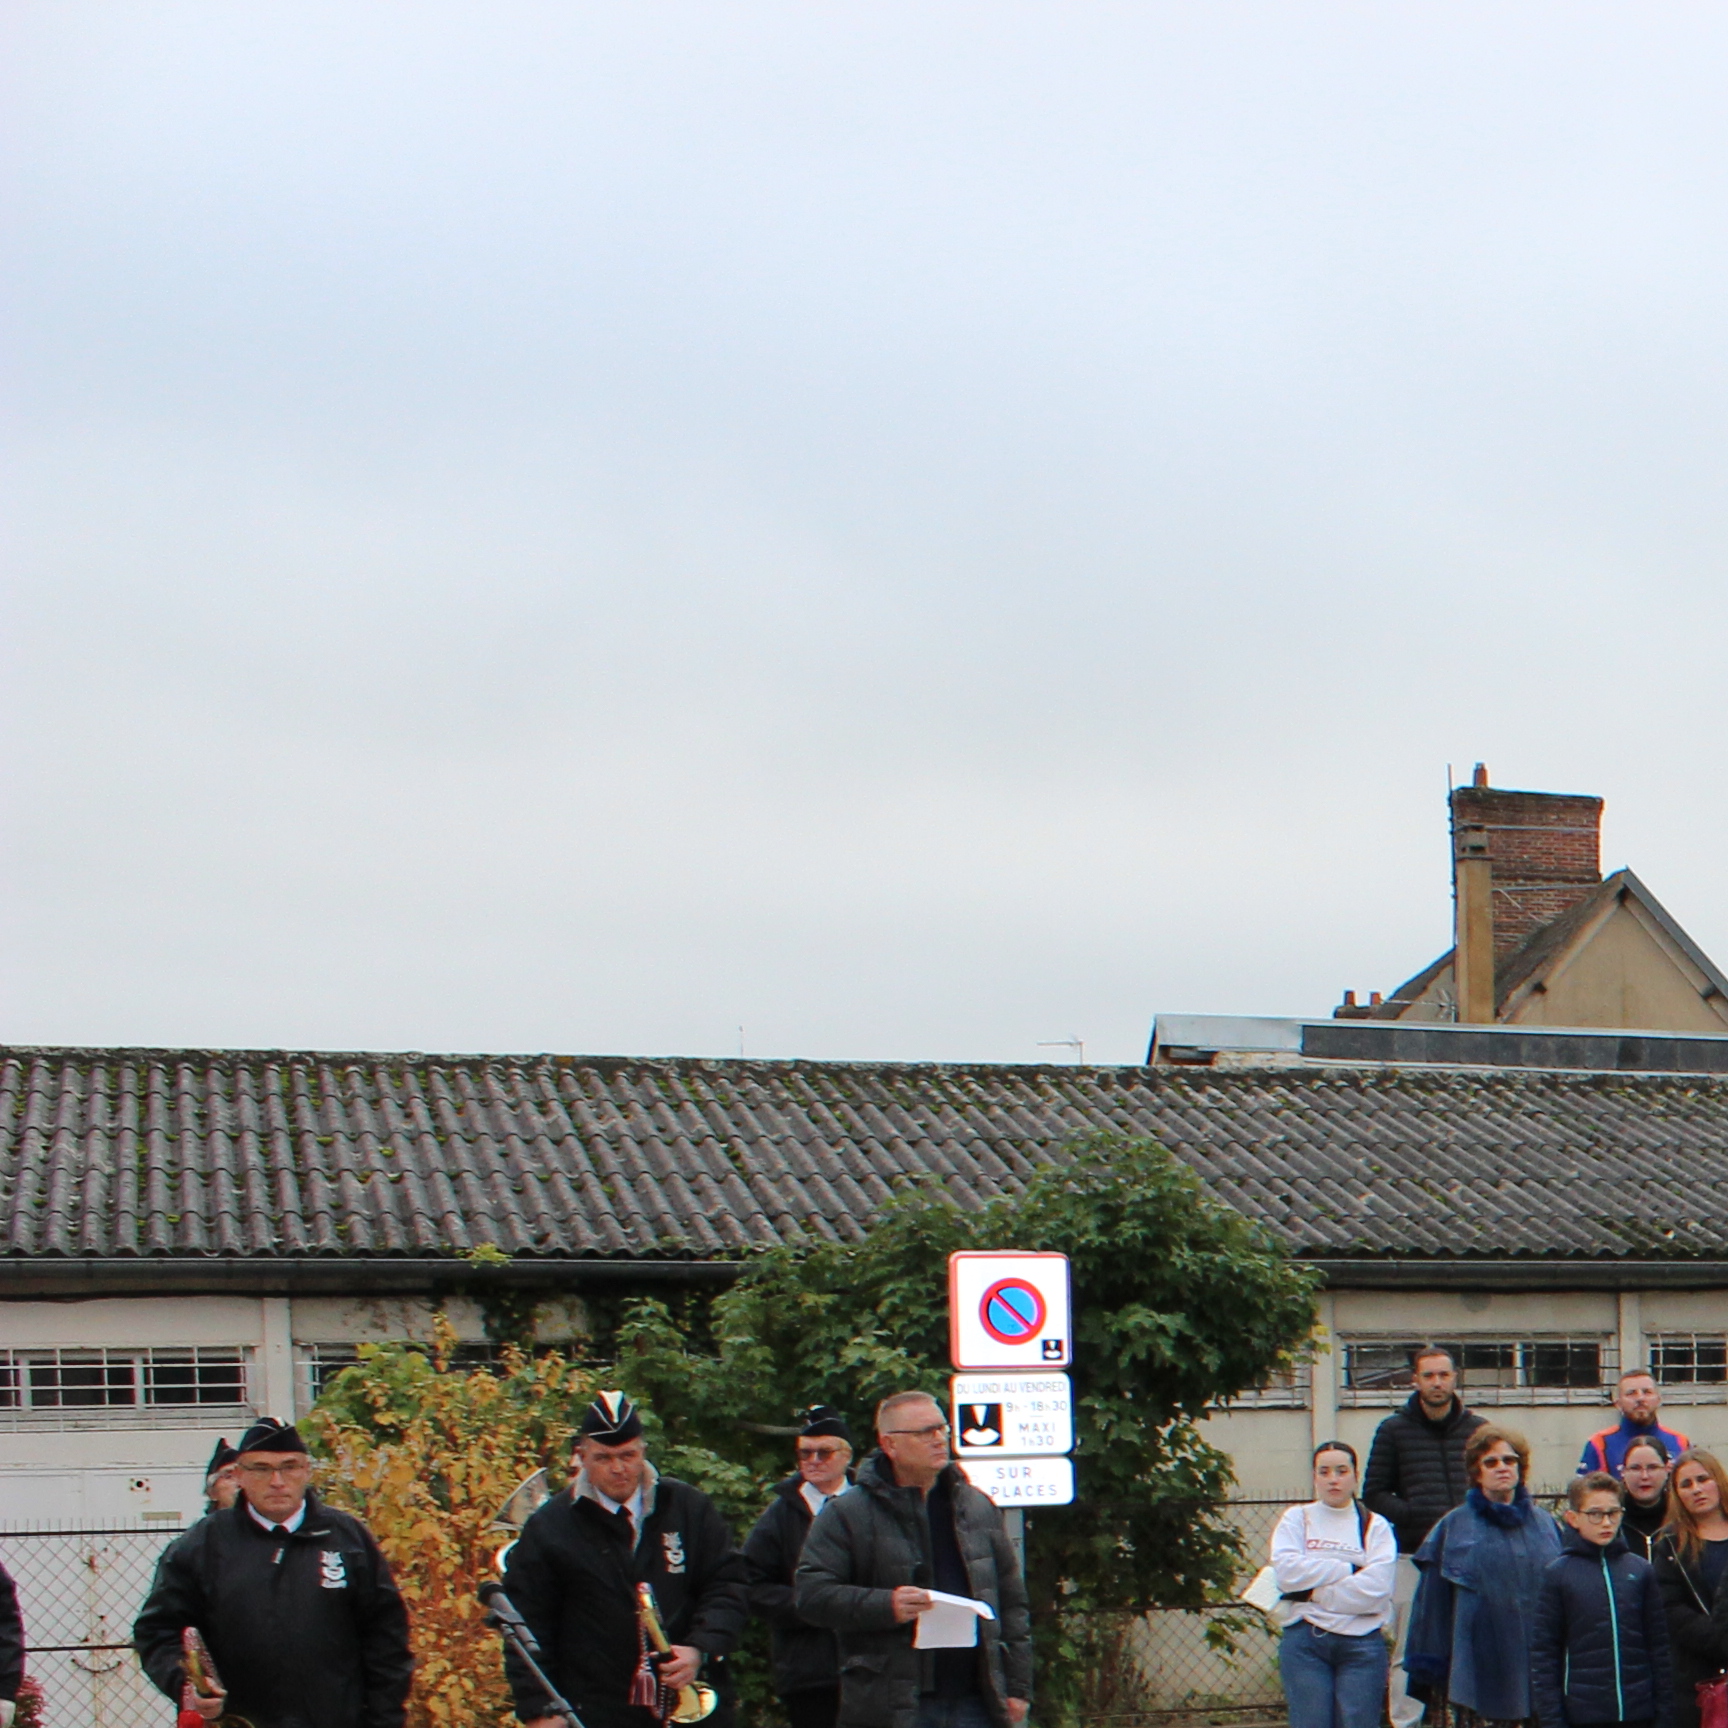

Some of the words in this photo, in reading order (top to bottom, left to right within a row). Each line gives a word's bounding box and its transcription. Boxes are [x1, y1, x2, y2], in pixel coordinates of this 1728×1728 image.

[956, 1383, 970, 1395] DU
[973, 1382, 1001, 1394] LUNDI
[1003, 1382, 1017, 1393] AU
[1018, 1422, 1055, 1433] MAXI
[995, 1466, 1032, 1480] SUR
[990, 1484, 1058, 1499] PLACES
